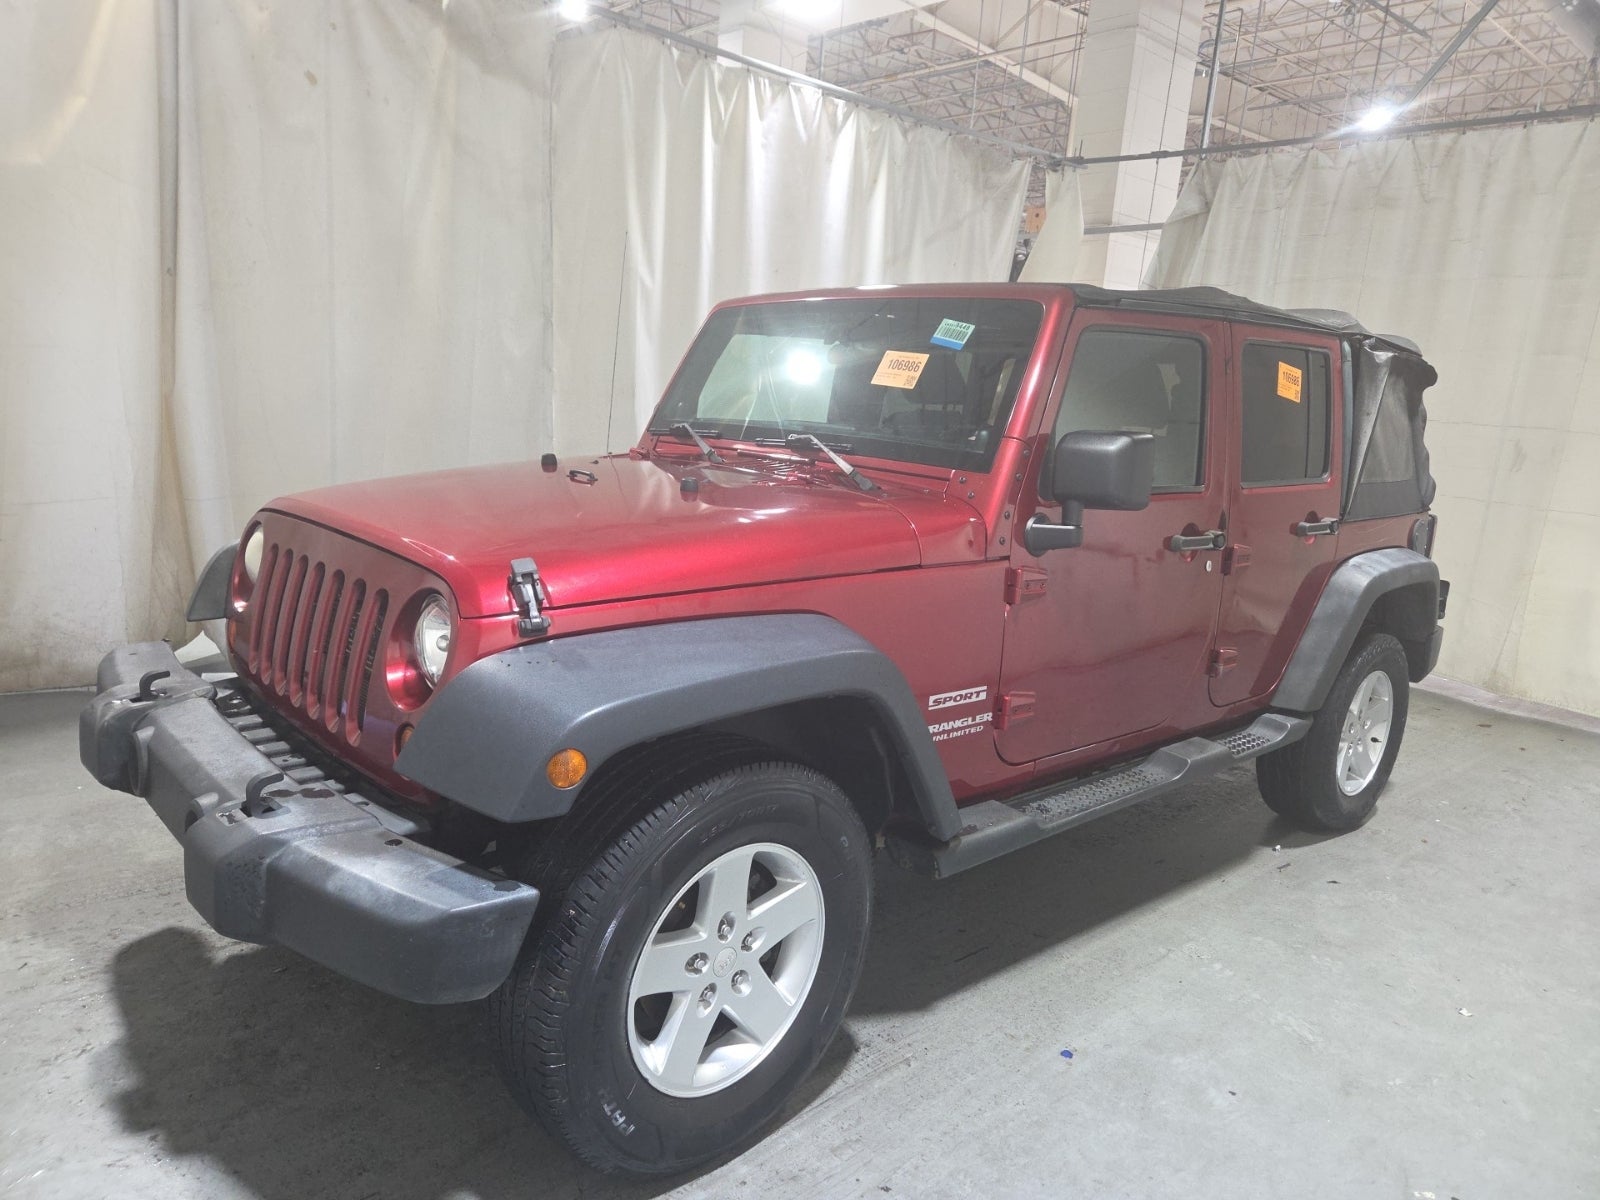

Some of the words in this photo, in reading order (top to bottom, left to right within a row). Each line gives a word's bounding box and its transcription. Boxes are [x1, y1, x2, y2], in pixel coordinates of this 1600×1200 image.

[888, 359, 922, 373] 106986
[929, 687, 987, 708] SPORT
[928, 712, 993, 734] RANGLER
